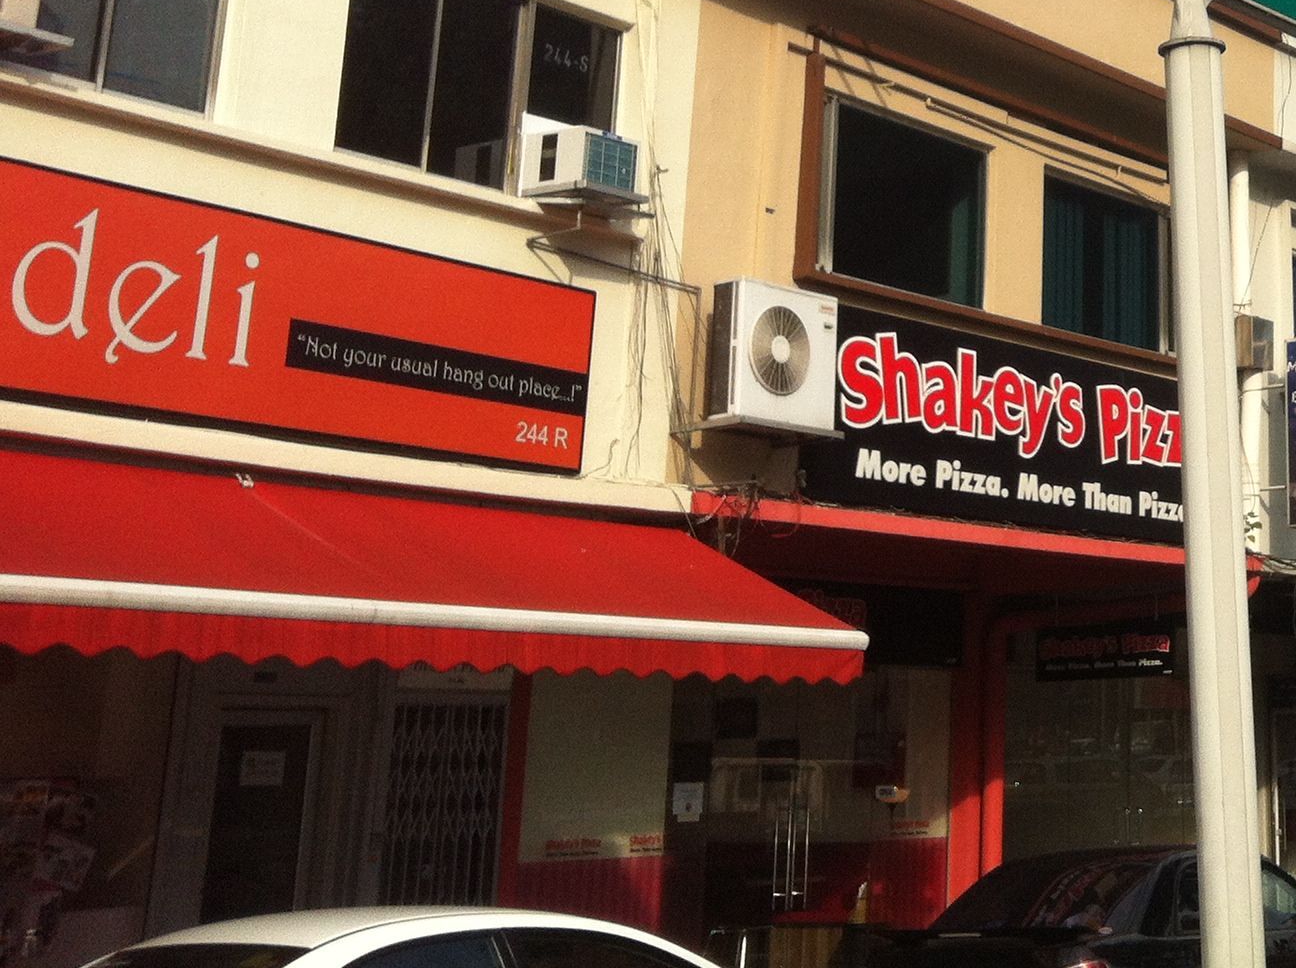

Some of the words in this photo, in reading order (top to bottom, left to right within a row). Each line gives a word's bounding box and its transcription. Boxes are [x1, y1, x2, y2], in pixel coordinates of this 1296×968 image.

[11, 207, 261, 368] deli
[342, 345, 388, 367] your
[391, 355, 439, 378] usual
[442, 361, 485, 390] hang
[488, 373, 515, 392] out
[836, 331, 1086, 459] Shakey's
[1096, 384, 1184, 468] Pizz
[514, 421, 549, 445] 244
[554, 427, 569, 449] R
[855, 447, 927, 487] More
[935, 459, 1010, 499] Pizza.
[1017, 472, 1077, 508] More
[1082, 481, 1133, 516] Than
[1138, 490, 1184, 523] Pizz
